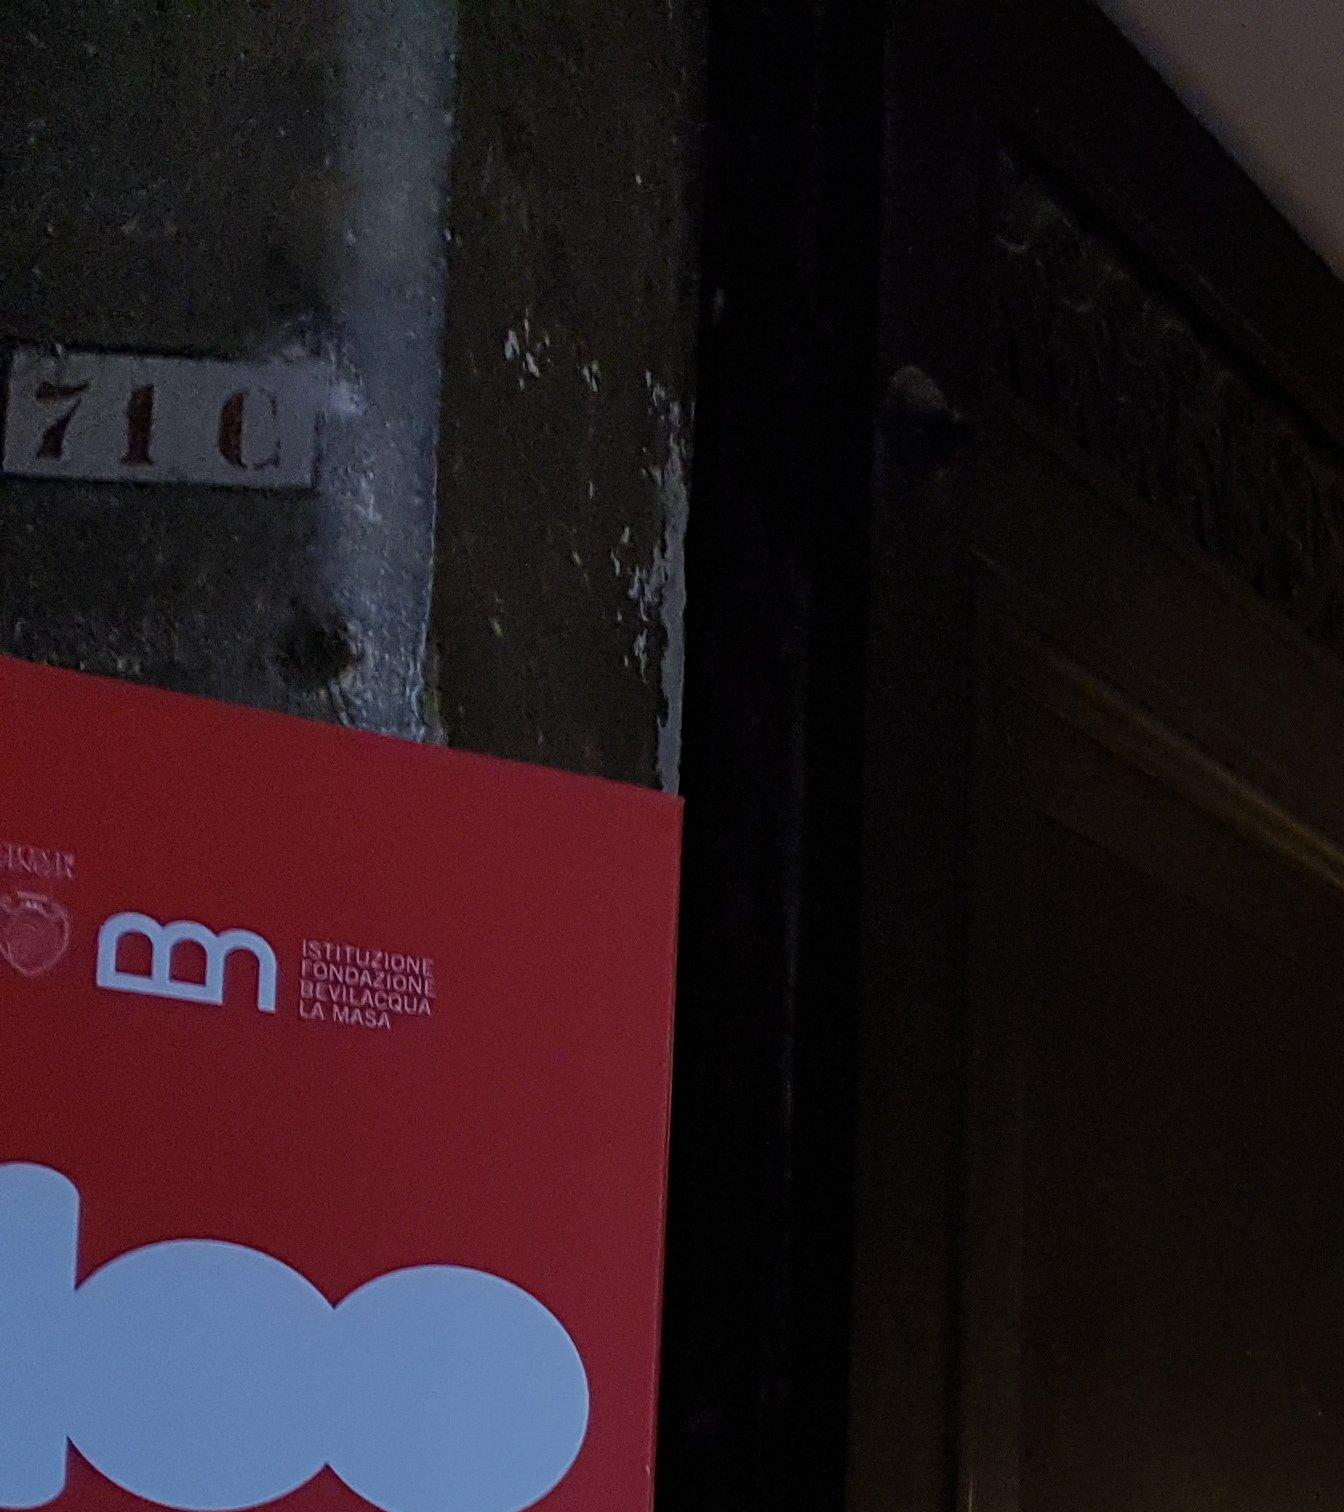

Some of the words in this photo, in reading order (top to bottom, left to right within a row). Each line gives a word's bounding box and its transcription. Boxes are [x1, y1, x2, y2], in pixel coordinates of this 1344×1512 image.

[302, 939, 435, 976] ISTITUZIONE
[300, 979, 431, 1016] BEVILACQUA
[301, 959, 437, 999] FONDAZIONE
[299, 998, 324, 1020] LA
[332, 1002, 391, 1031] MASA
